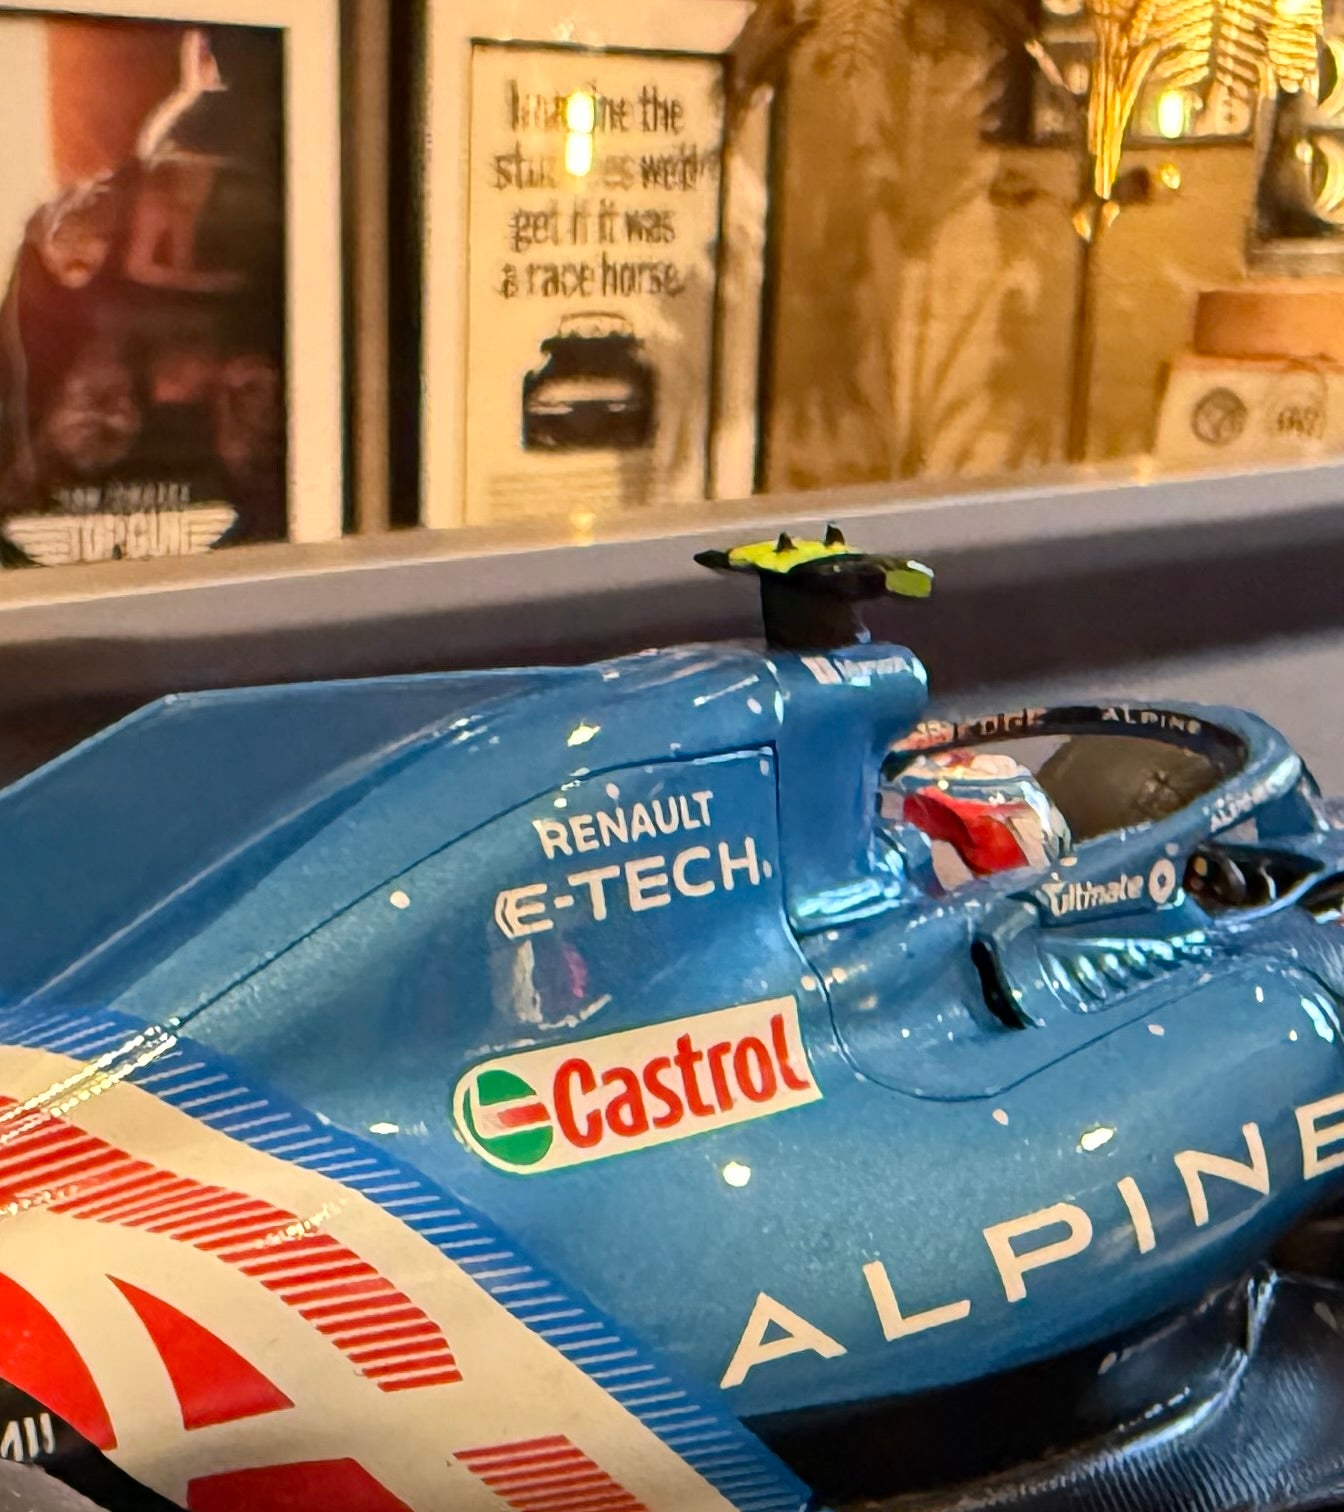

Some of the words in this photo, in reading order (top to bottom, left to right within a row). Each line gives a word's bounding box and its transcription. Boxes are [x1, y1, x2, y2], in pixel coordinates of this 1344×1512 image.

[639, 85, 686, 134] the
[508, 197, 561, 252] get
[623, 207, 677, 244] was
[533, 789, 714, 859] RENAULT
[552, 1012, 812, 1149] Castrol
